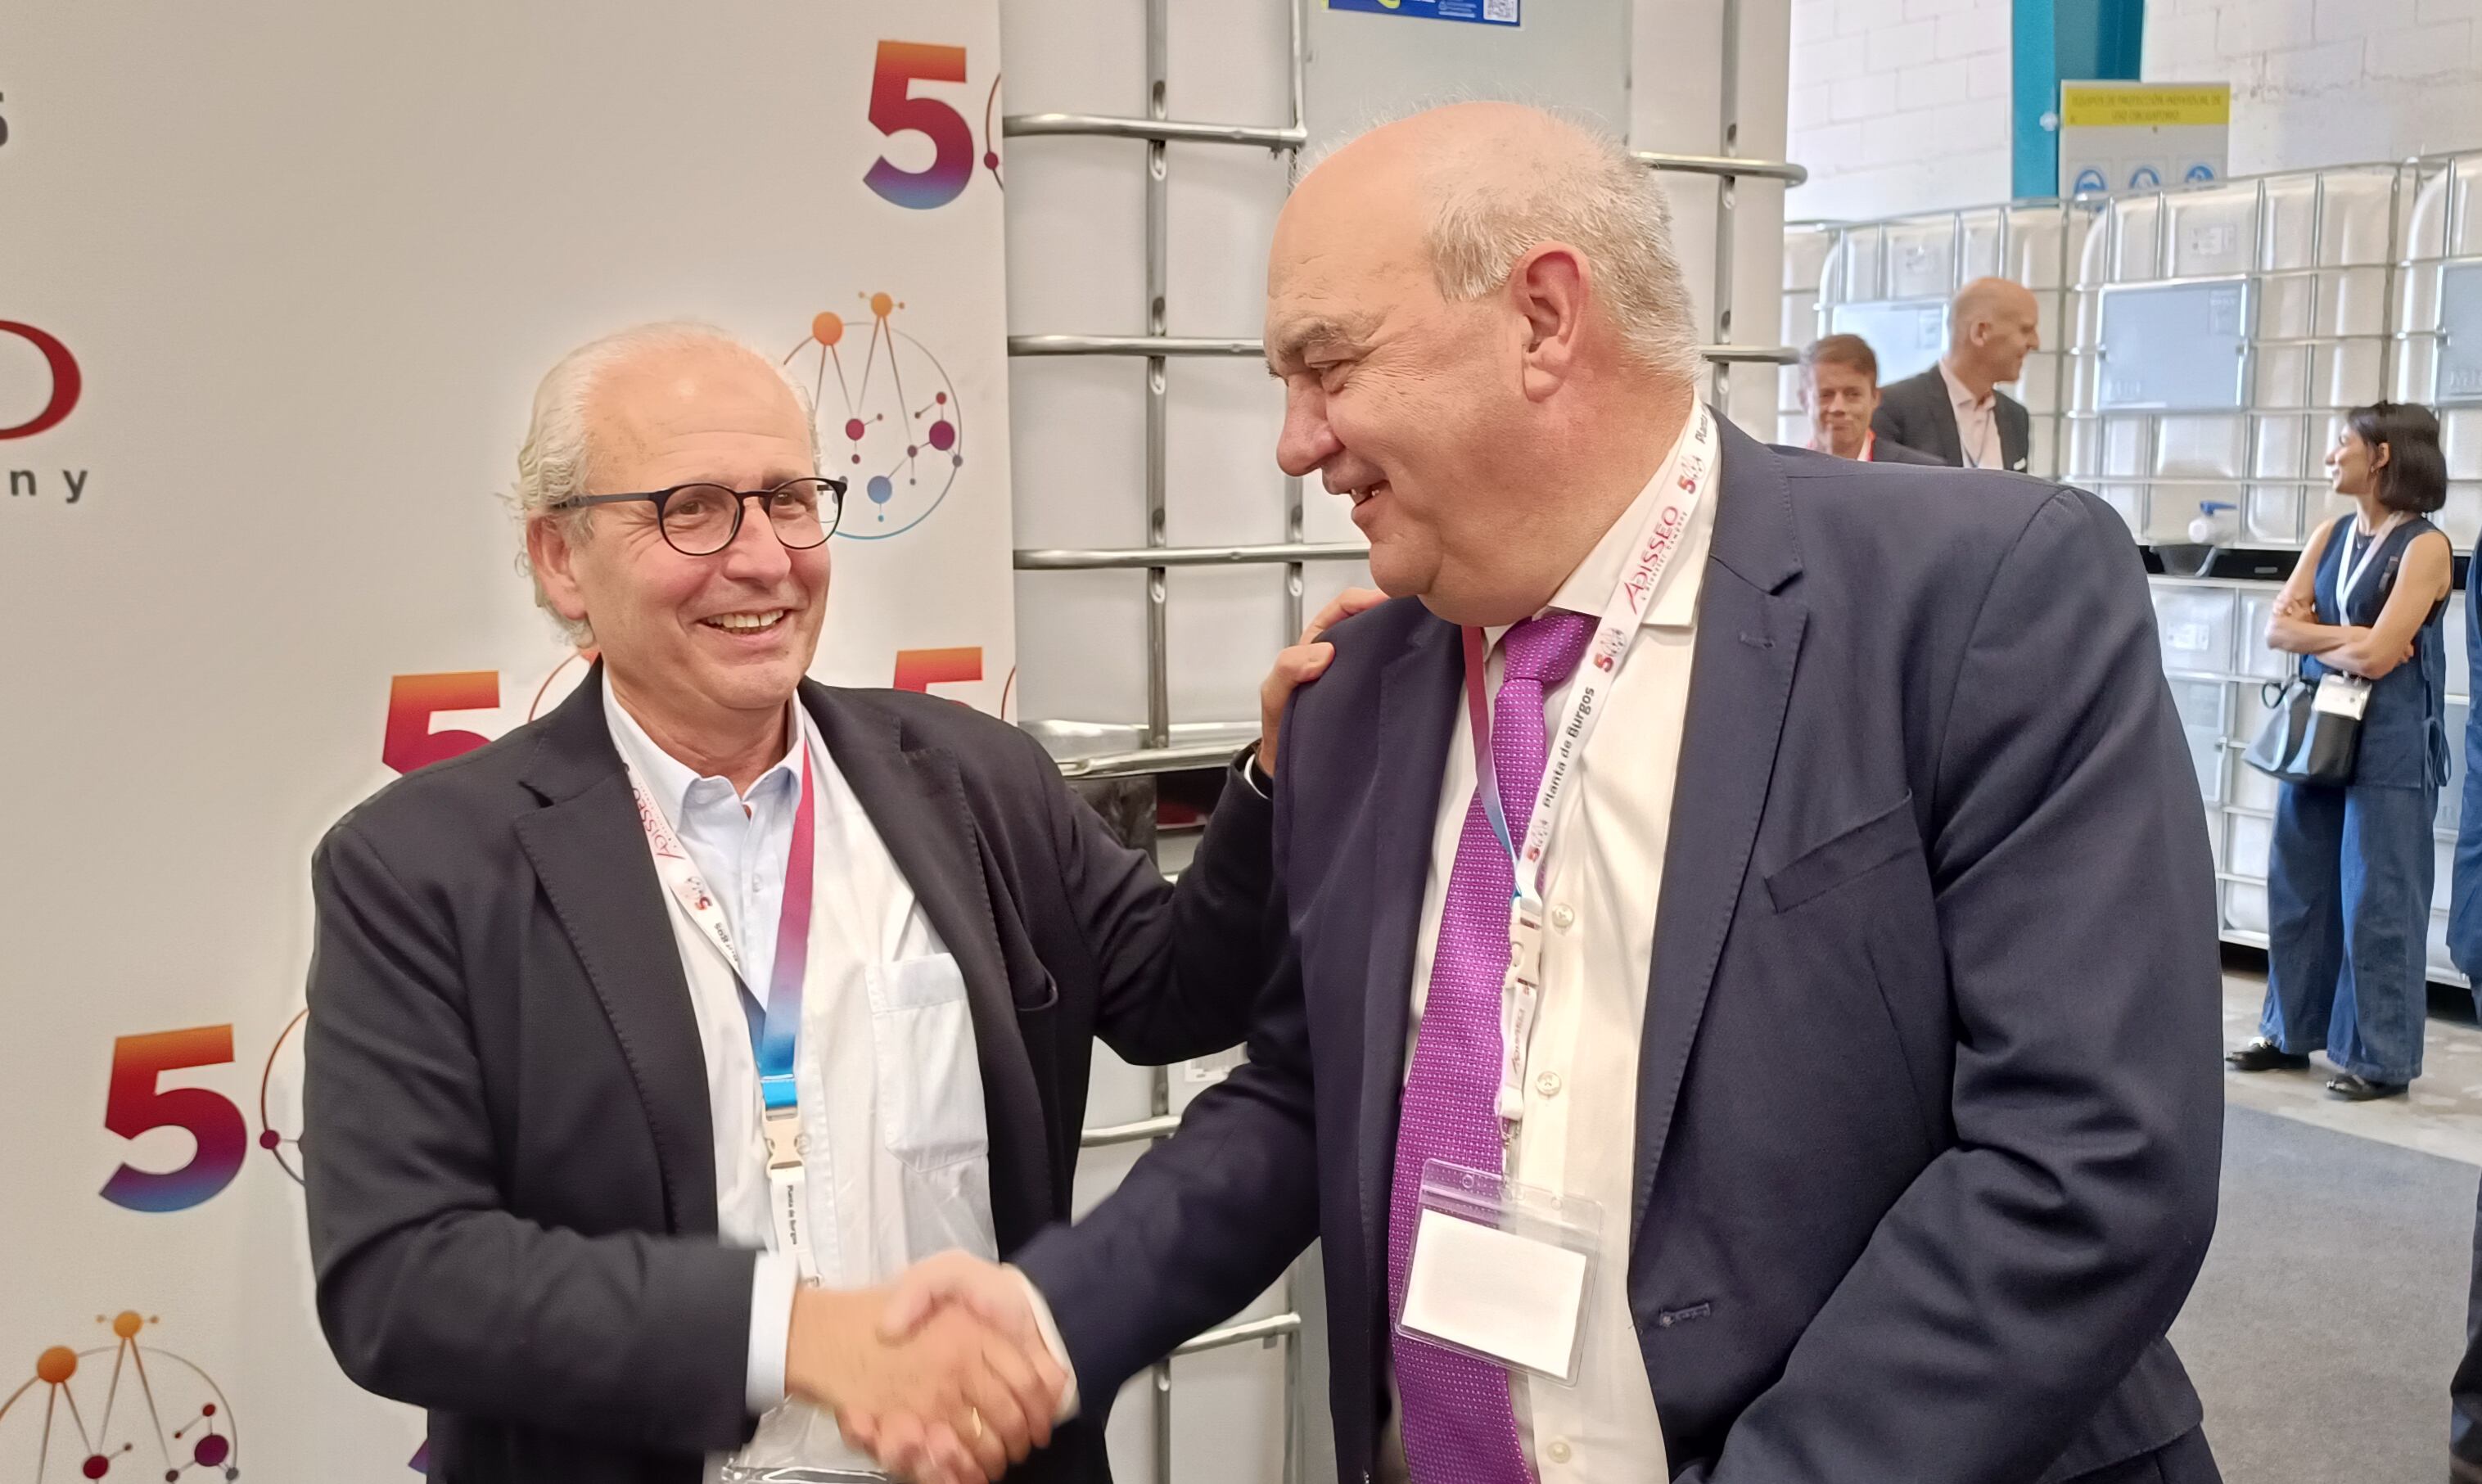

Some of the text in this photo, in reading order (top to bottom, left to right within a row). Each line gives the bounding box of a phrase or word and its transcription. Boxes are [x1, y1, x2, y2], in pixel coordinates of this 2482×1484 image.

[863, 39, 974, 210] 5
[1624, 506, 1678, 616] ADISSEO
[1543, 686, 1595, 808] Planta de Burgos
[98, 1023, 248, 1213] 5
